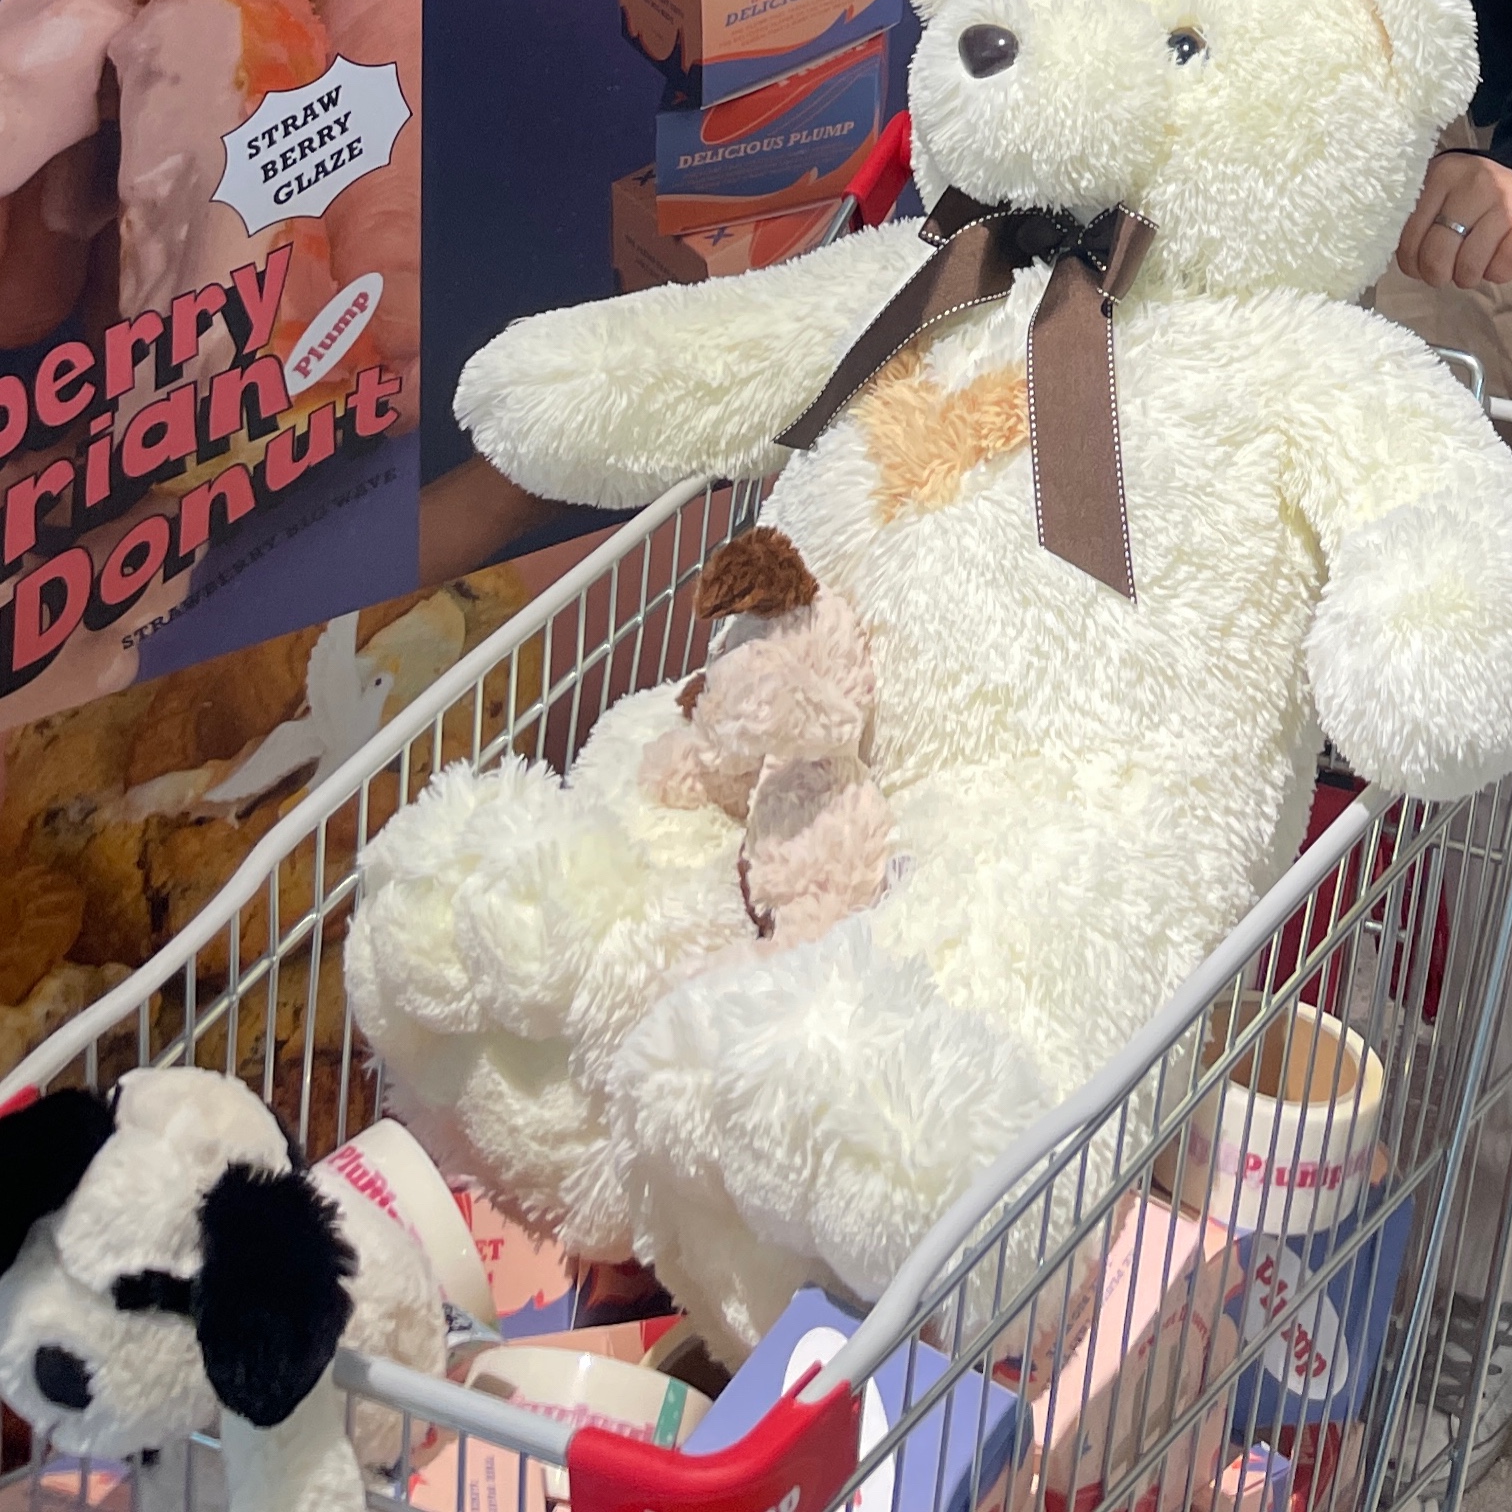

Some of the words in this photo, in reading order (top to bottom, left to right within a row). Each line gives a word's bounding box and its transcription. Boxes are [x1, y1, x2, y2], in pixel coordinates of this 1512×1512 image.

[247, 85, 343, 161] STRAW
[259, 110, 354, 184] BERRY
[676, 135, 786, 171] DELICIOUS
[787, 120, 856, 148] PLUMP
[272, 136, 365, 207] GLAZE
[292, 289, 372, 380] Plump
[11, 364, 404, 674] Donut
